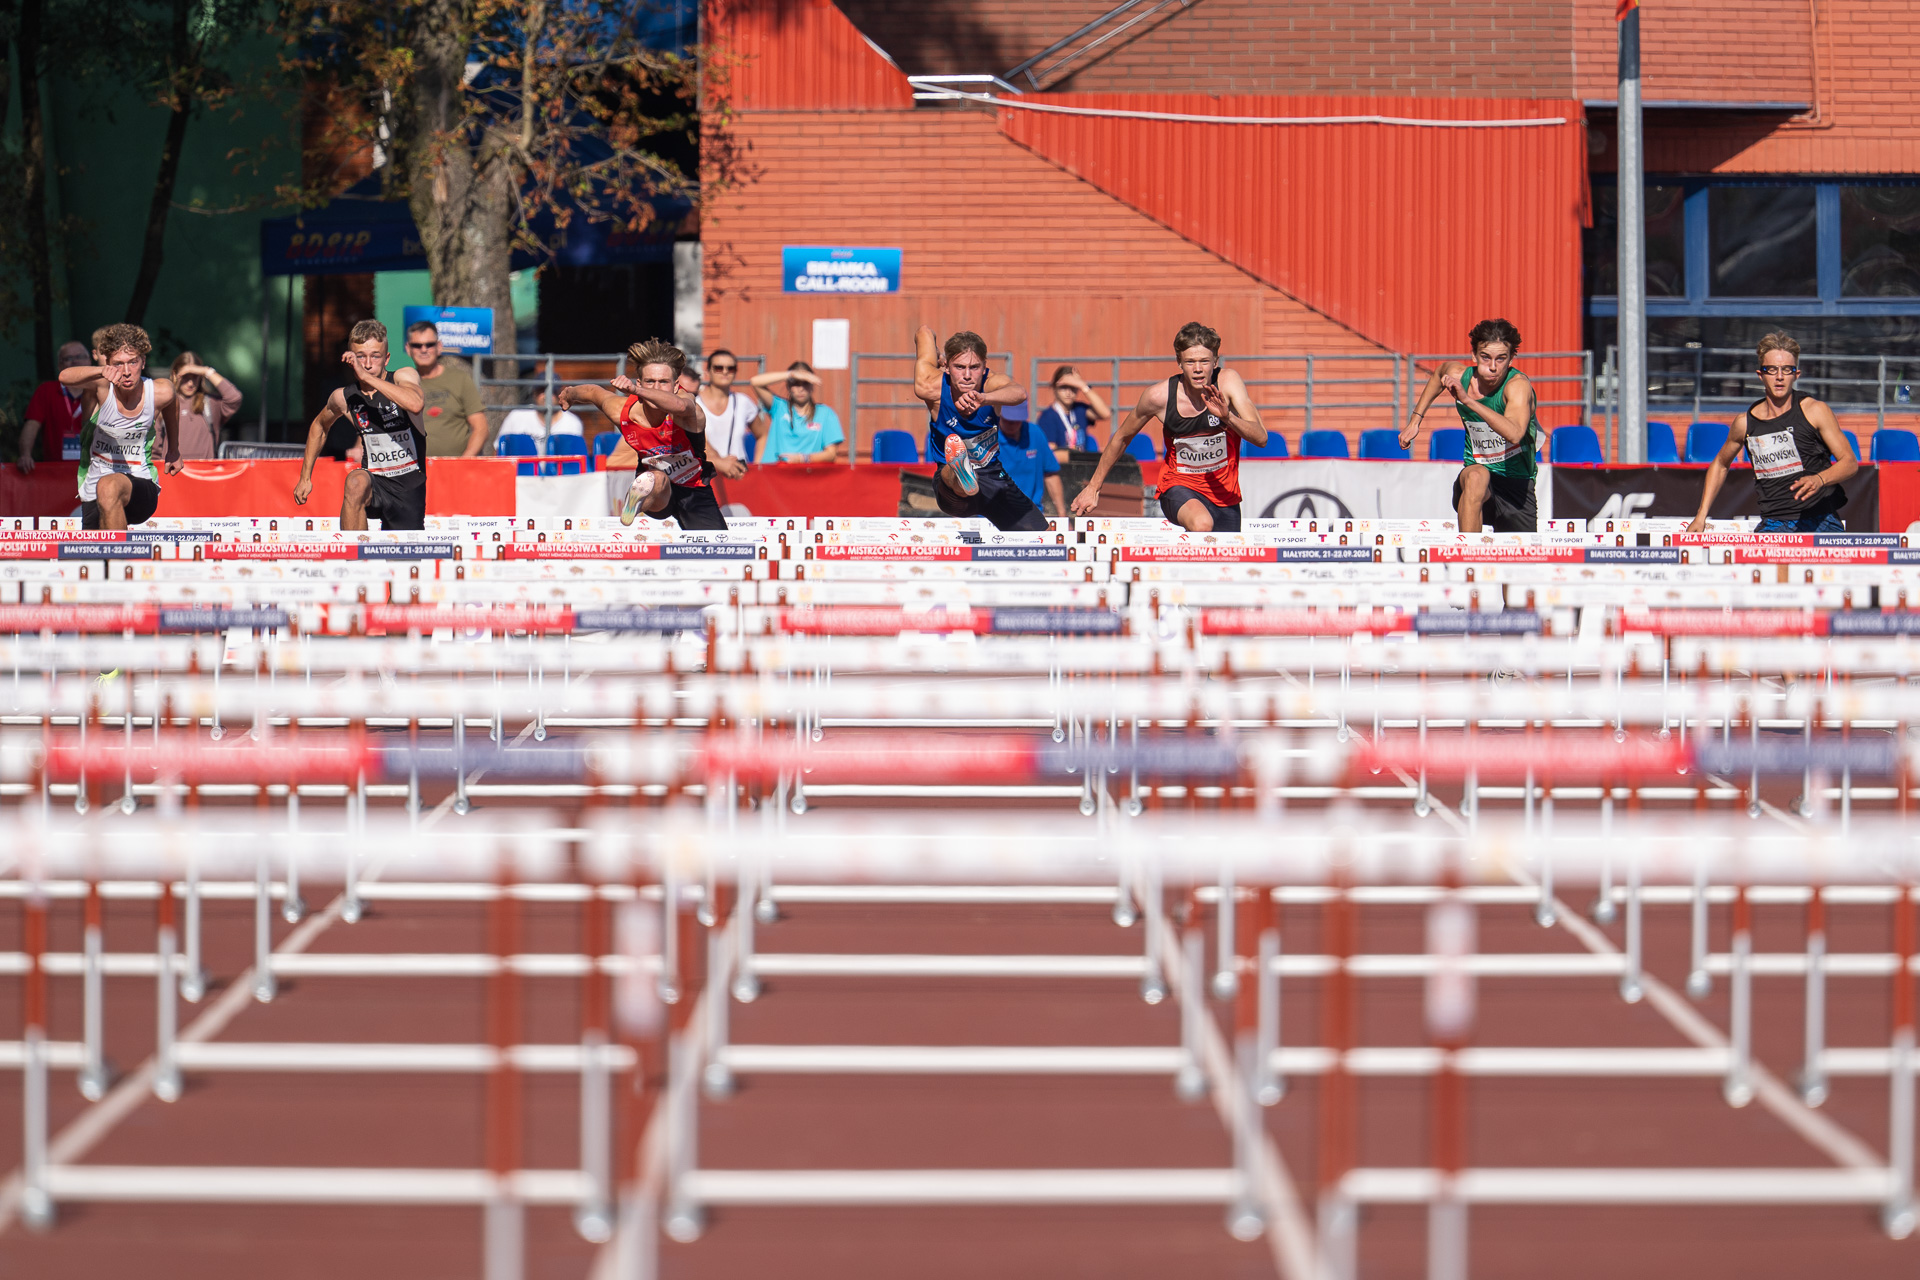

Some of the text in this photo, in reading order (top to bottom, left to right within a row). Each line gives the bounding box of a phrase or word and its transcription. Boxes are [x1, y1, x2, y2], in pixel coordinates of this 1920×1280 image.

[807, 260, 878, 276] BRAMKA
[795, 276, 889, 293] CALL-ROOM
[124, 432, 142, 440] 214
[391, 433, 410, 443] 410
[1771, 434, 1789, 445] 735
[1203, 437, 1222, 447] 458
[95, 440, 141, 456] STANIEWICZ
[371, 448, 413, 463] DOŁĘGA
[1179, 448, 1224, 462] ĆWIKŁO
[1754, 449, 1796, 465] ANKOWSKI
[15, 531, 70, 540] MISTRZOSTWA
[72, 531, 98, 540] POLSKI
[101, 531, 116, 540] U16
[1680, 534, 1804, 543] PZLA MISTRZOSTWA POLSKI U16
[1819, 538, 1897, 546] BIAŁYSTOK, 21-22.09.2024
[31, 543, 46, 552] U16
[104, 546, 150, 554] 21-22.09.2024
[213, 544, 346, 553] PZLA MISTRZOSTWA POLSKI U16
[404, 546, 450, 554] 21-22.09.2024
[514, 544, 648, 553] PZLA MISTRZOSTWA POLSKI U16
[706, 547, 752, 555] 21-22.09.2024
[825, 546, 960, 555] PZLA MISTRZOSTWA POLSKI U16
[1130, 548, 1265, 556] PZLA MISTRZOSTWA POLSKI U16
[1438, 548, 1573, 556] PZLA MISTRZOSTWA POLSKI U16
[1018, 549, 1064, 557] 21-22.09.2024
[1323, 550, 1371, 558] 21-22.09.2024
[1630, 551, 1677, 559] 21-22.09.2024
[1743, 549, 1876, 558] PZLA MISTRZOSTWA POLSKI U16
